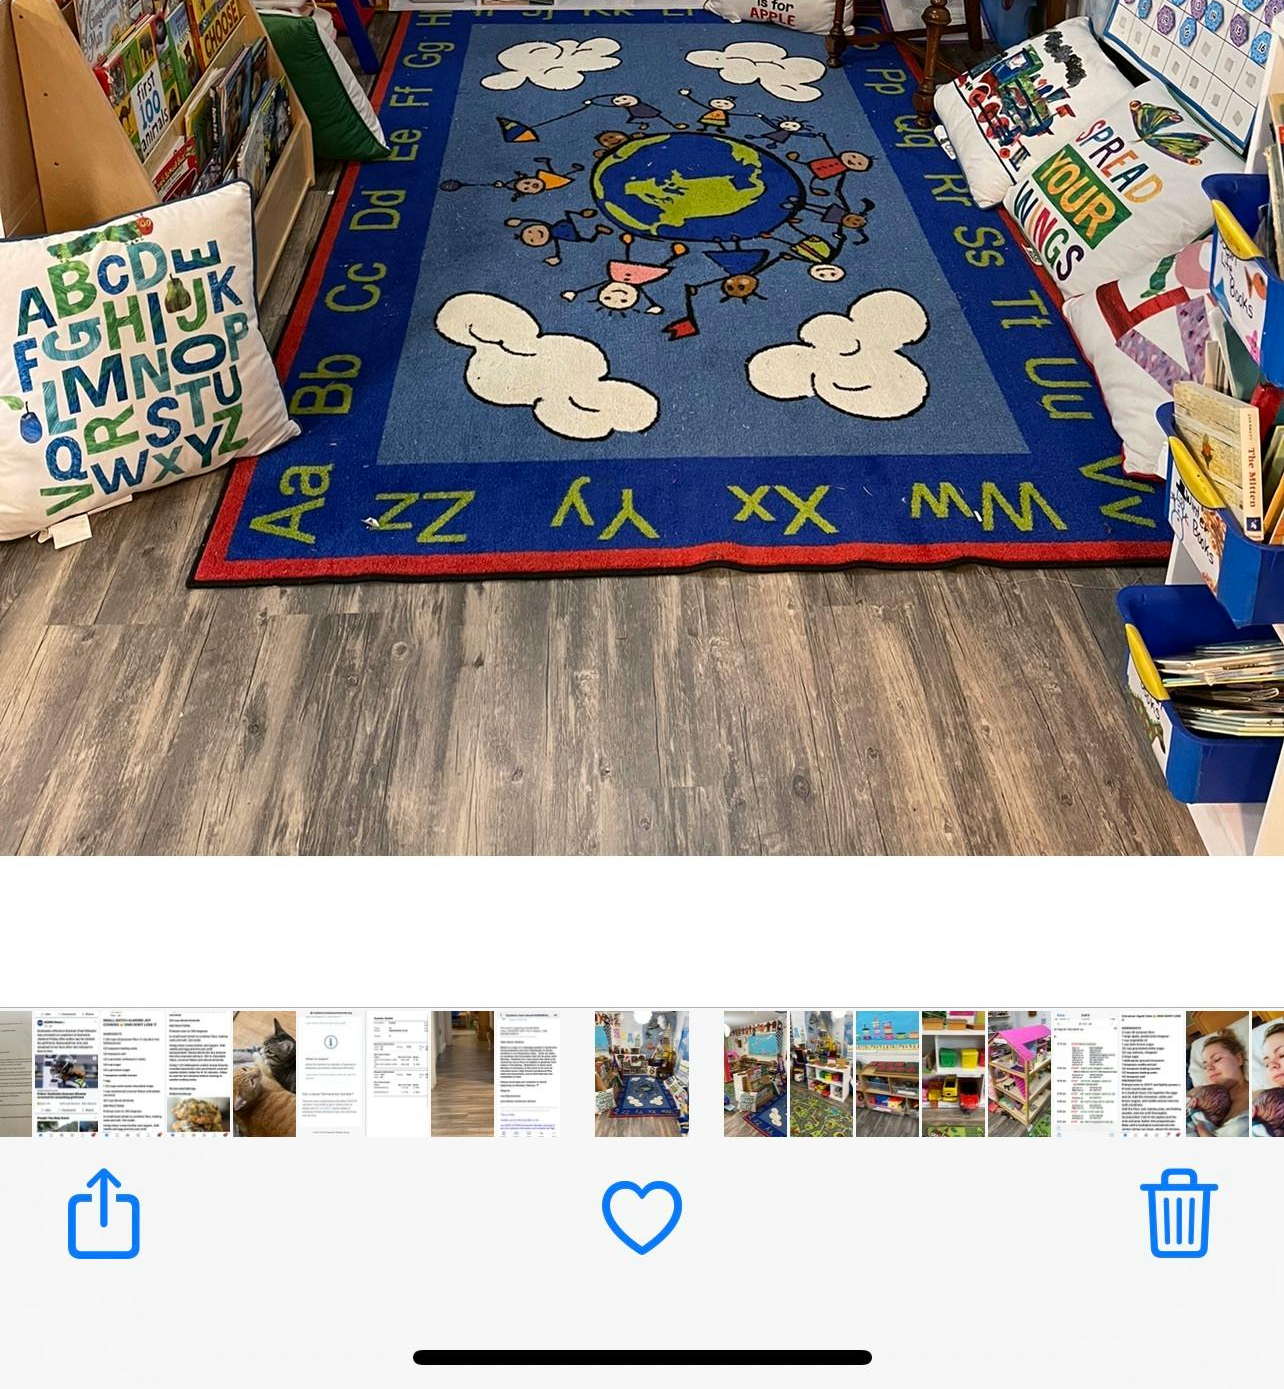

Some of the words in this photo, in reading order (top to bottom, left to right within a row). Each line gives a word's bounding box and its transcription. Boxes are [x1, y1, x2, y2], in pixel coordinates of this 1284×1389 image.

[204, 0, 240, 60] CHOOSE
[750, 7, 796, 27] APPLE
[402, 41, 455, 69] Gg
[137, 70, 156, 104] first
[389, 85, 433, 108] Ff
[863, 67, 908, 97] Pp
[139, 89, 162, 131] 100
[140, 107, 169, 153] animals
[1075, 118, 1164, 204] SPREAD
[349, 189, 407, 232] Dd
[1039, 148, 1117, 241] YOUR
[953, 225, 1007, 268] Ss
[1013, 179, 1085, 282] WINGS
[325, 262, 388, 314] Cc
[991, 289, 1054, 330] Tt
[289, 354, 363, 416] Bb
[1024, 357, 1096, 421] Uu
[1248, 446, 1256, 469] The
[249, 462, 336, 546] Aa
[549, 475, 661, 541] Yy
[726, 484, 840, 536] Xx
[910, 480, 1068, 532] Ww
[1248, 471, 1257, 509] Mitten
[1192, 518, 1216, 566] Books
